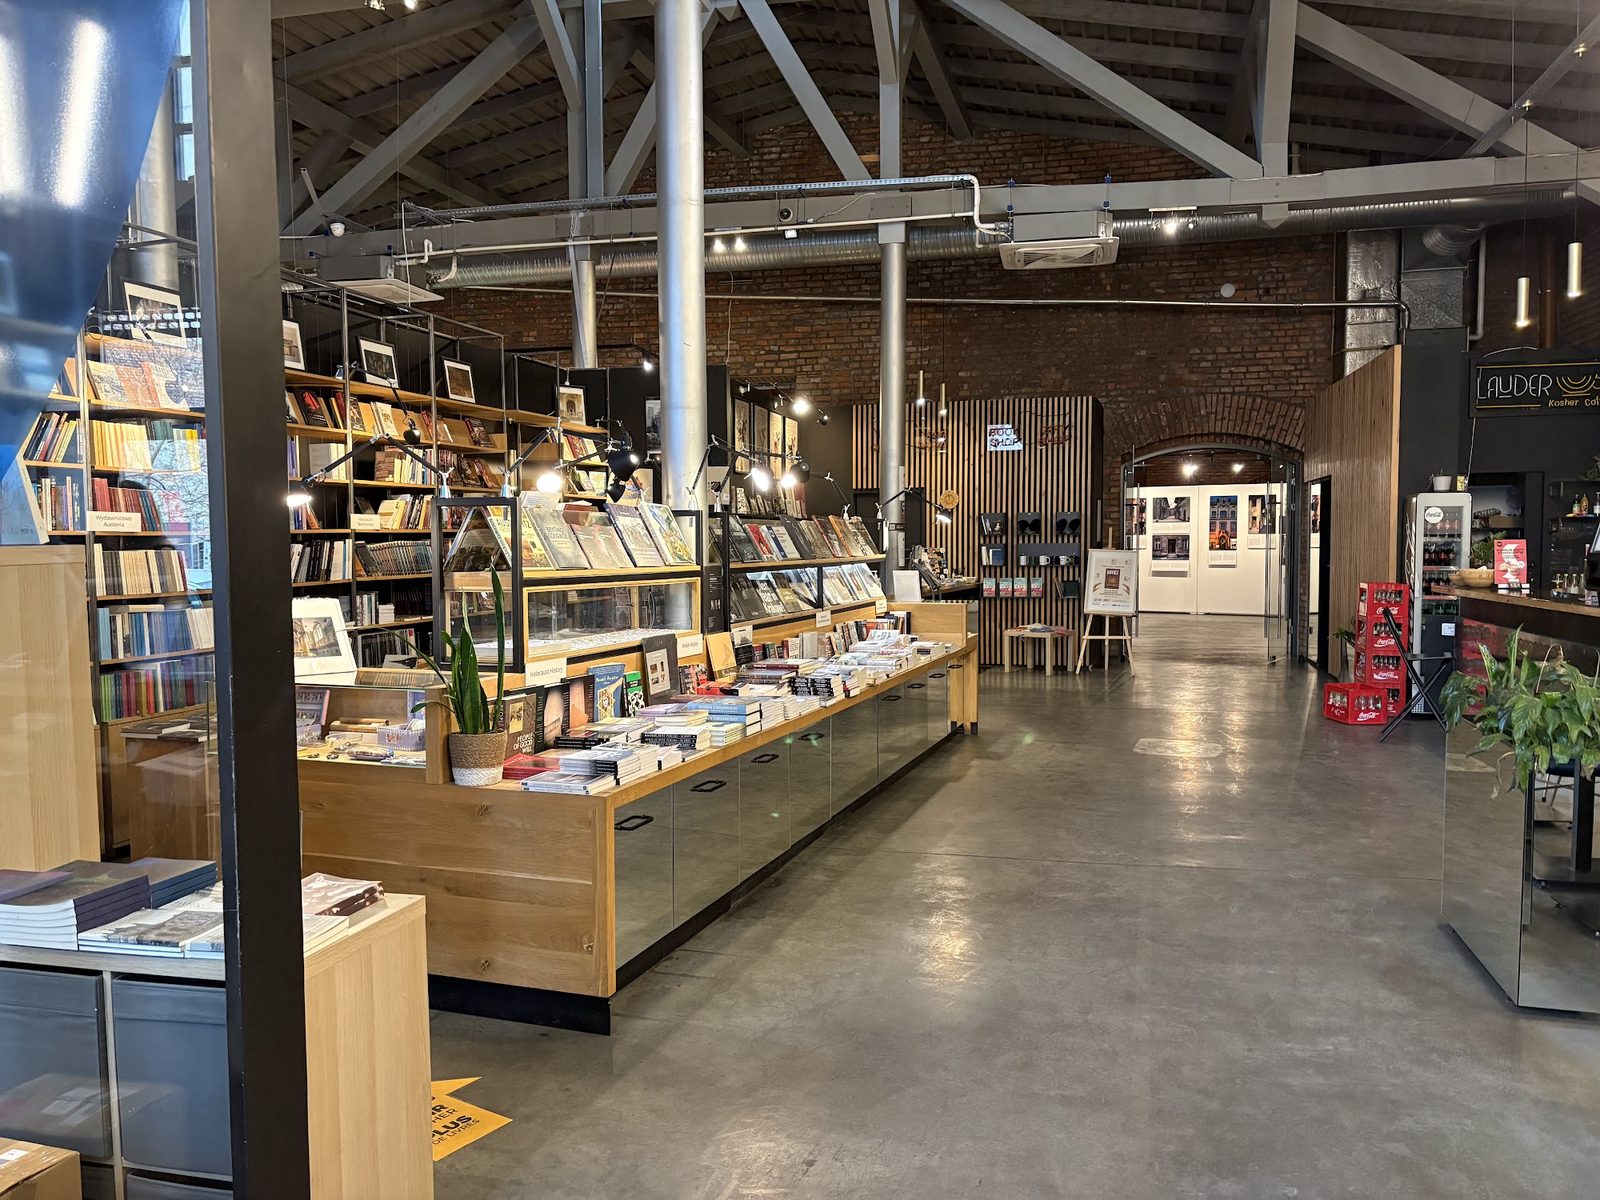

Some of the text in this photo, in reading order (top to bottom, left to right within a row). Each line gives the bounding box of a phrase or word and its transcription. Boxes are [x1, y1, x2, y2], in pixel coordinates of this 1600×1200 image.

[1477, 374, 1553, 399] LAUDER
[1548, 395, 1600, 408] Kosher Caf
[990, 427, 1021, 437] BOOK
[990, 437, 1023, 447] SHOP
[529, 669, 550, 678] Holocaust
[517, 733, 535, 743] PEOPLE
[513, 740, 533, 751] OF GOOD
[521, 746, 533, 754] WILL
[431, 1115, 472, 1138] LUS
[446, 1119, 480, 1137] LIVRES
